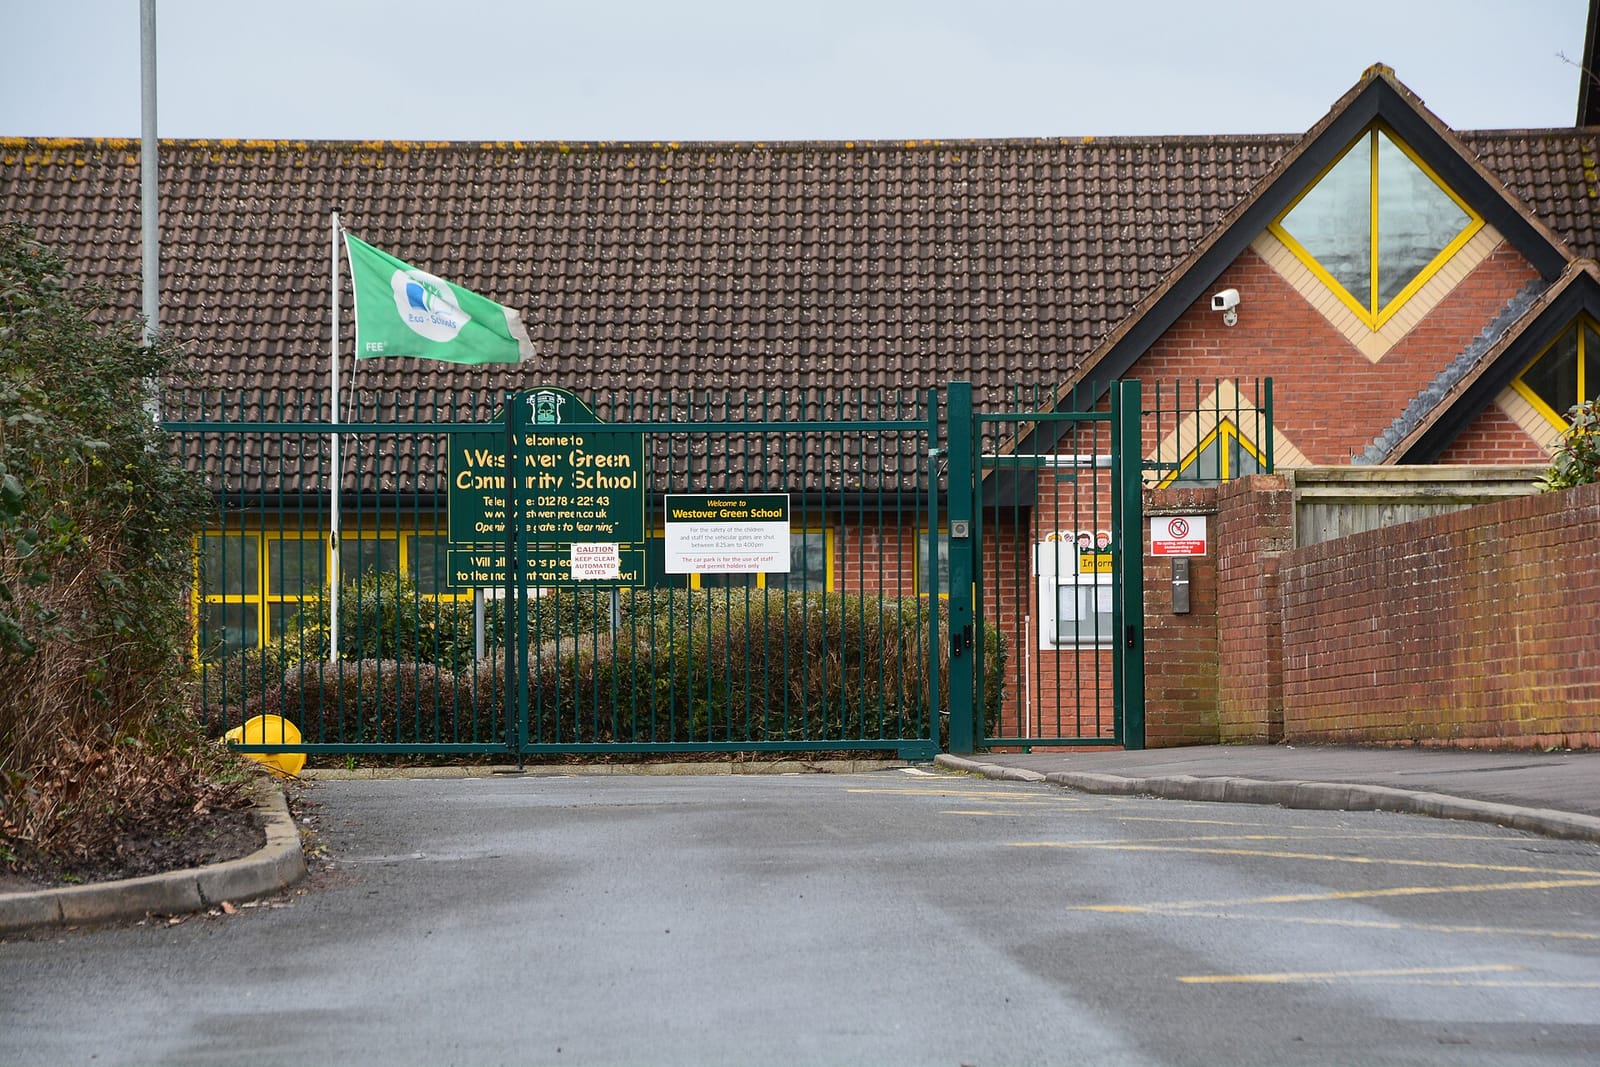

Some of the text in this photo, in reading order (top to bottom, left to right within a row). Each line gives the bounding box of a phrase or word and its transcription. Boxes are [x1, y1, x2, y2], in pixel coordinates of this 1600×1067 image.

[366, 342, 384, 352] FEE
[570, 434, 584, 446] to
[463, 449, 631, 468] Wesver Green
[456, 470, 637, 492] Comnity School
[537, 496, 568, 507] 01278
[672, 508, 783, 519] Westover Green School
[563, 522, 574, 532] to
[456, 570, 469, 581] to
